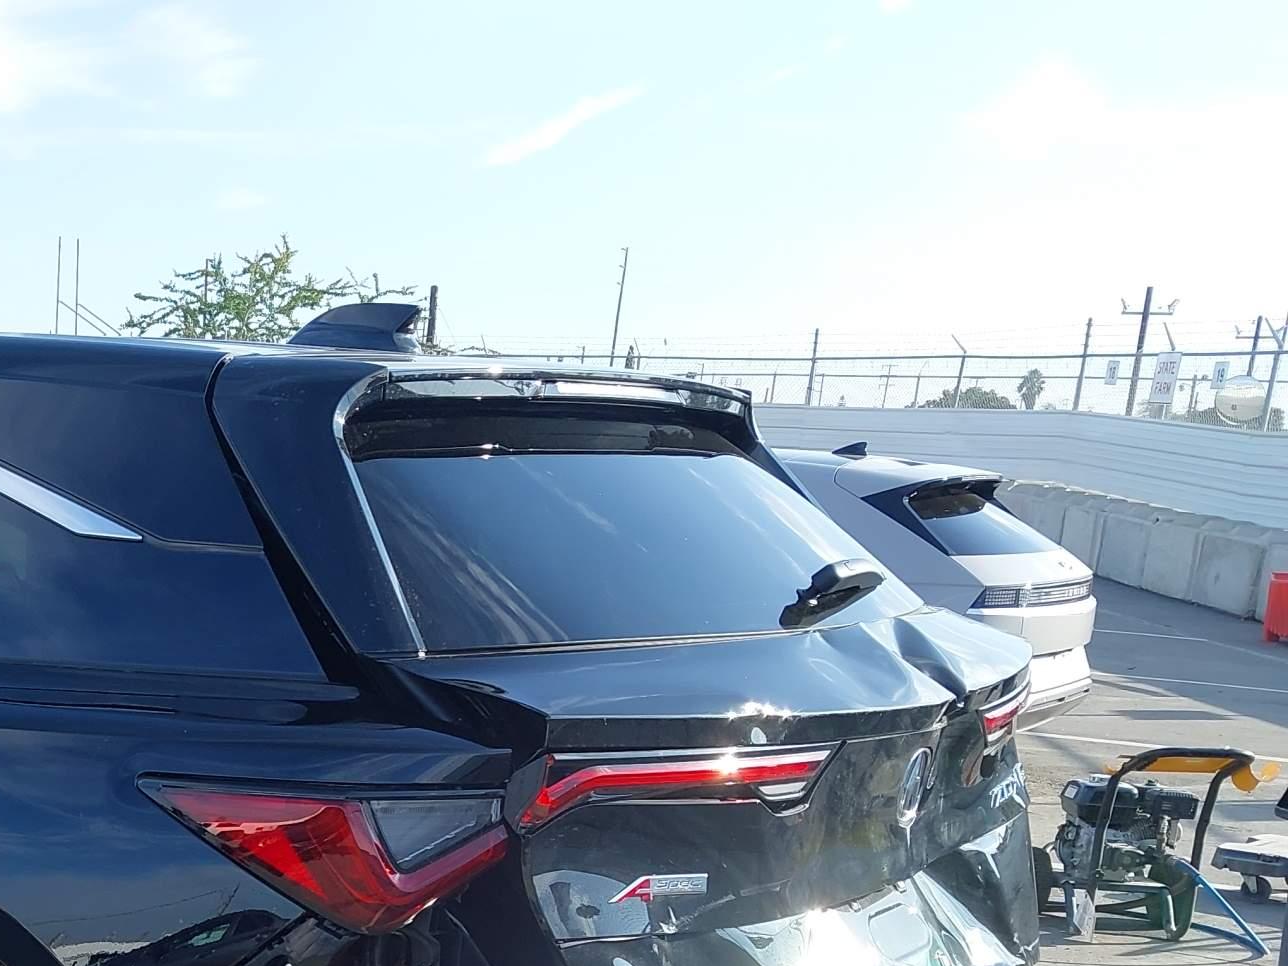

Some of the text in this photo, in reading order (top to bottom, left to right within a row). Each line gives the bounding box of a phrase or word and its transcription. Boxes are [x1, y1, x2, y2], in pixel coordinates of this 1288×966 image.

[1157, 361, 1177, 375] STATE
[1216, 367, 1226, 383] 19
[1154, 381, 1172, 395] FARM
